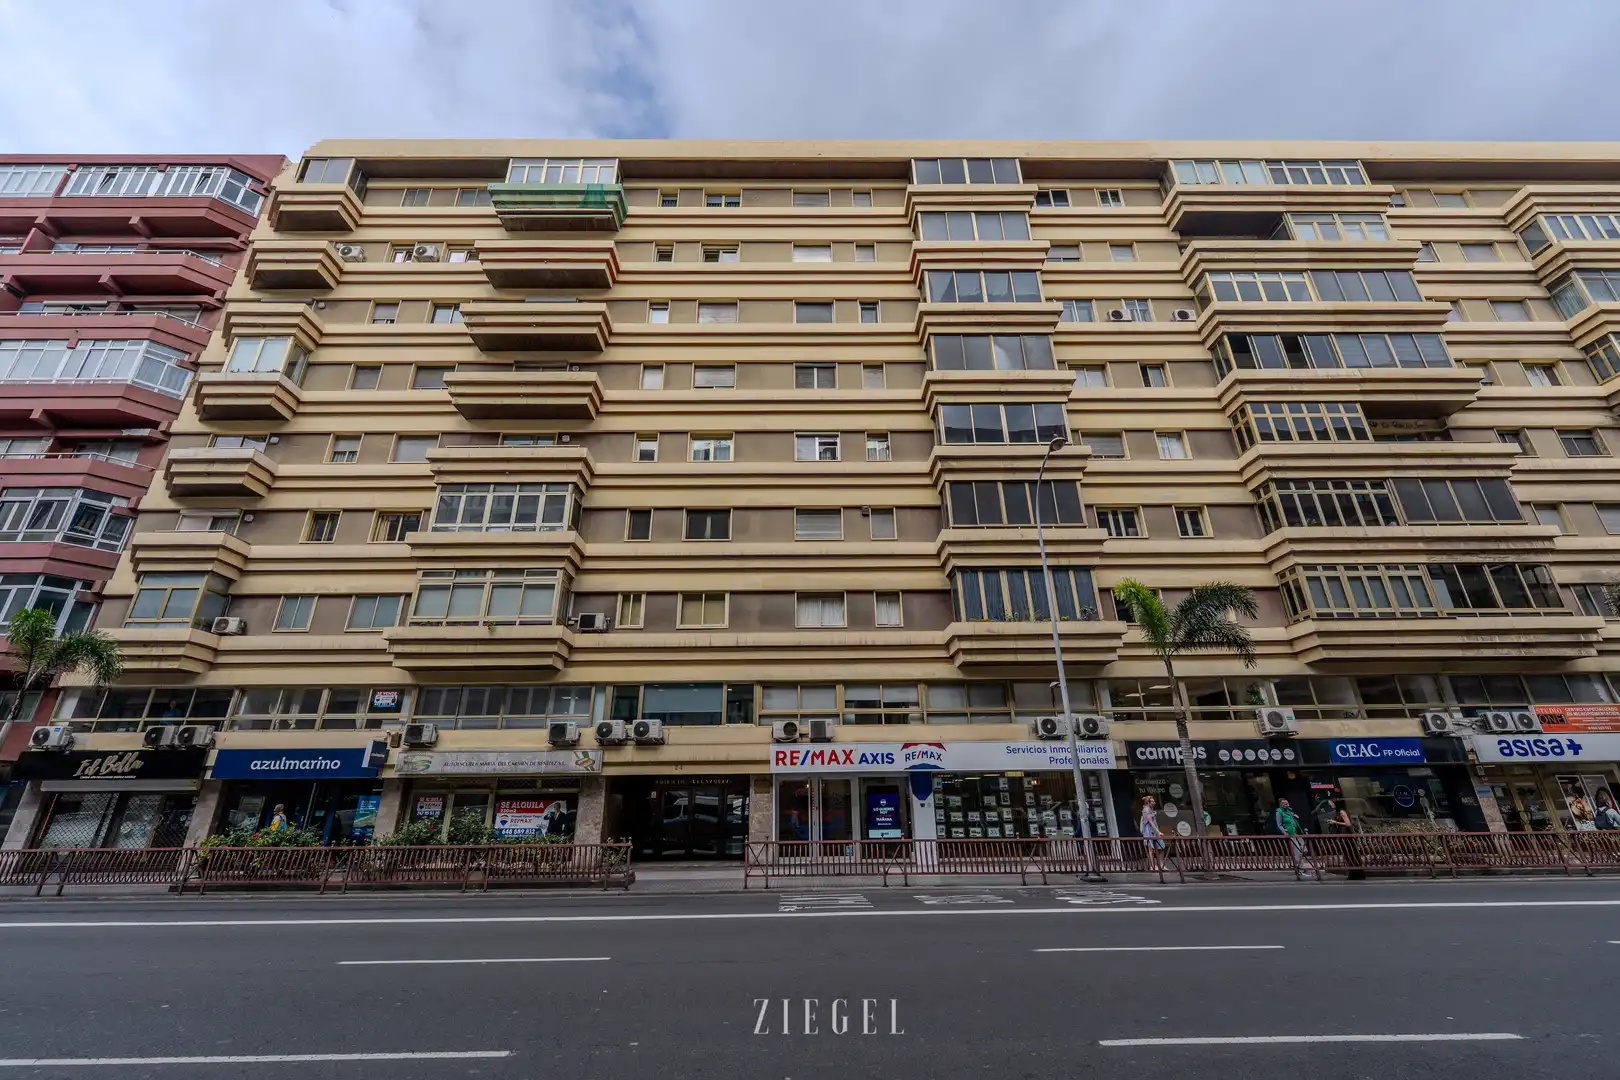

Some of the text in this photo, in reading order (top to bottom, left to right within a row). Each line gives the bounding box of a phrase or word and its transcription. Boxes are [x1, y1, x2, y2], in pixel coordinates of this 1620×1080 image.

[1006, 744, 1108, 754] Servicios Inmoiliarios
[1335, 743, 1421, 758] CEAC FP Oficial
[1497, 738, 1565, 757] asisa
[250, 756, 341, 770] azulmarino
[775, 749, 895, 767] RE/MAX AXIS
[904, 750, 943, 762] RE/MAX
[1049, 756, 1110, 765] Profeonales
